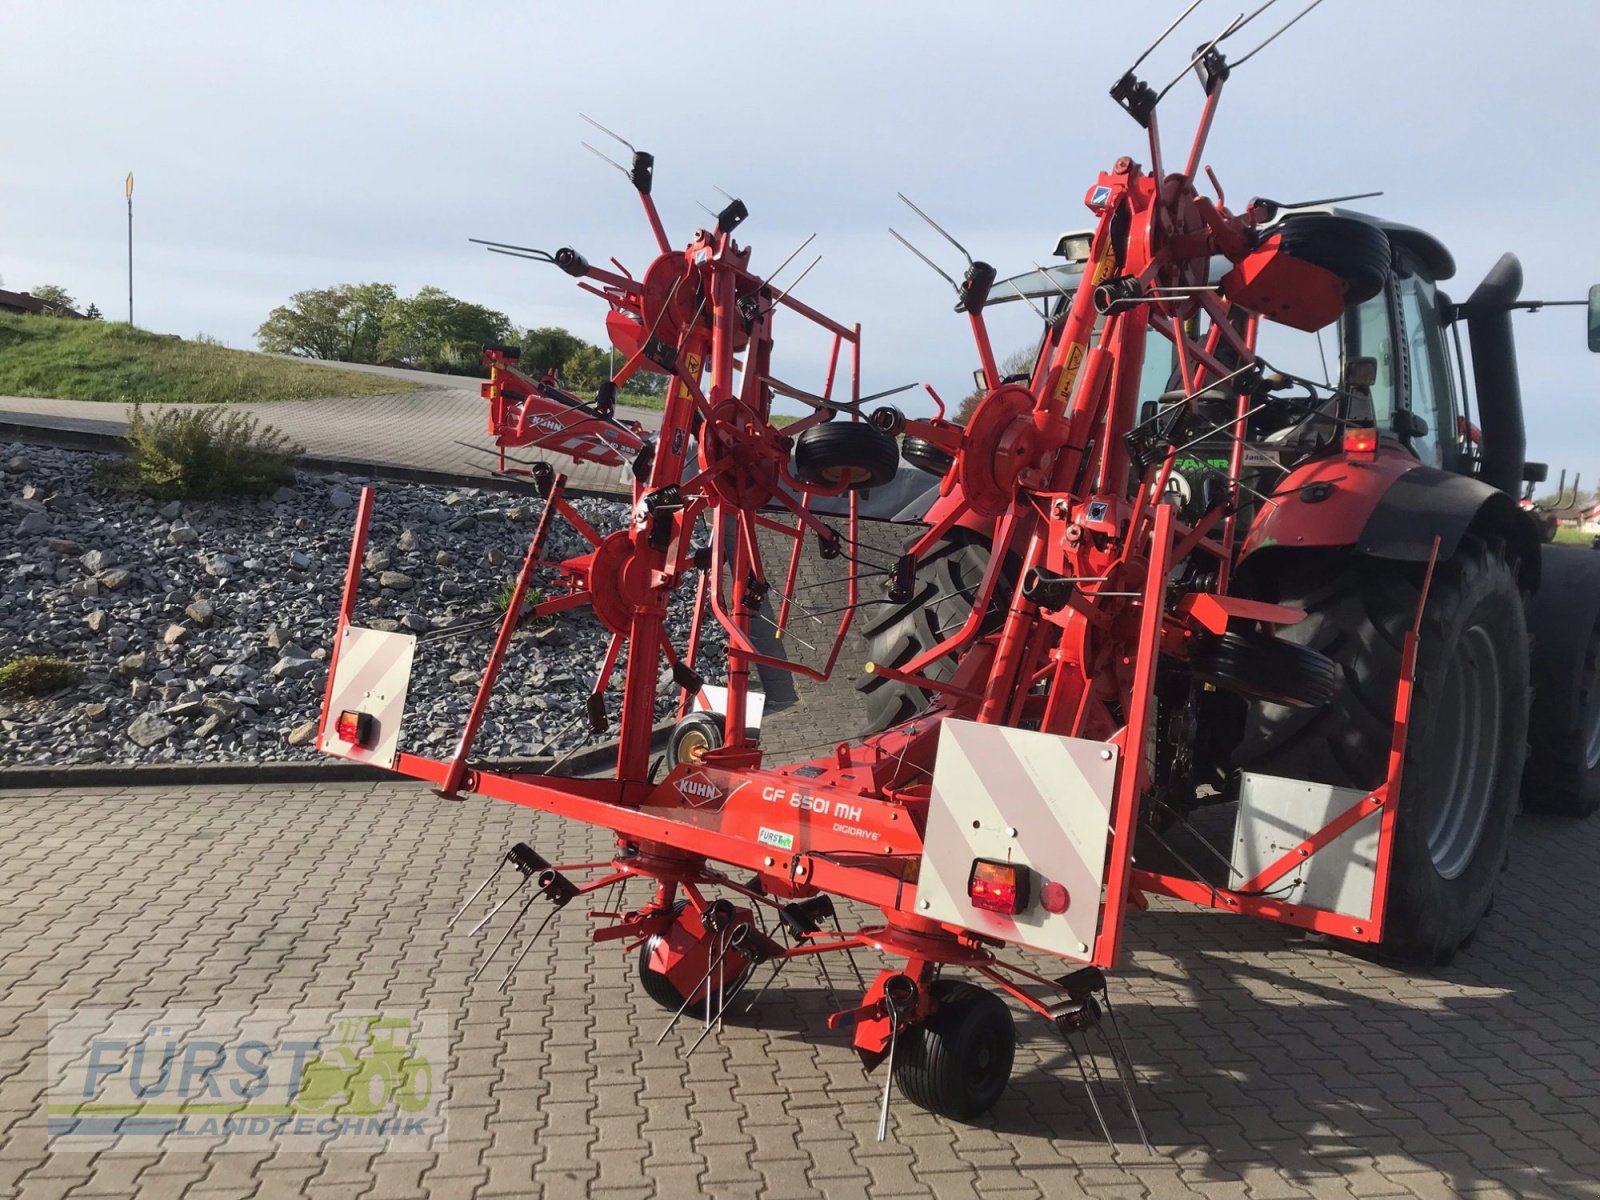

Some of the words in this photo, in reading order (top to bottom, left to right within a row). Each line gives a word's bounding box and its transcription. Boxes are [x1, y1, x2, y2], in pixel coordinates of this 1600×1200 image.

[679, 779, 716, 800] KUHN
[762, 786, 785, 803] GF
[789, 793, 830, 813] 8501
[834, 802, 863, 822] MH
[832, 823, 880, 841] DIGIDRIVE
